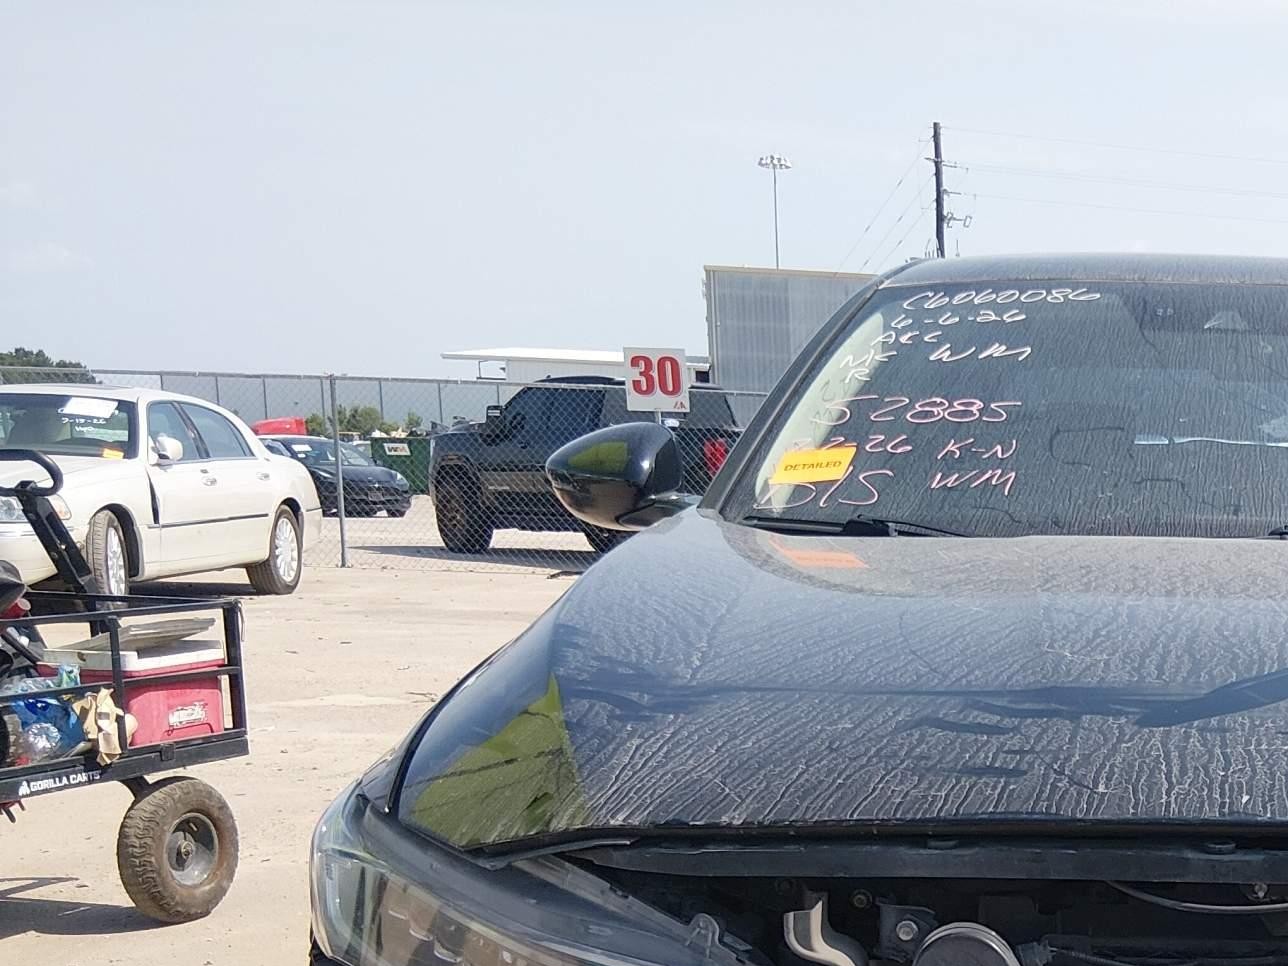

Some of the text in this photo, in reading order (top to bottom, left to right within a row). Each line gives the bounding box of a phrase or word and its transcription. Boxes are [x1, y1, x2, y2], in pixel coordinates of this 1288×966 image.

[630, 355, 682, 396] 30
[783, 461, 843, 472] DETAILED
[30, 777, 69, 791] GORILLA
